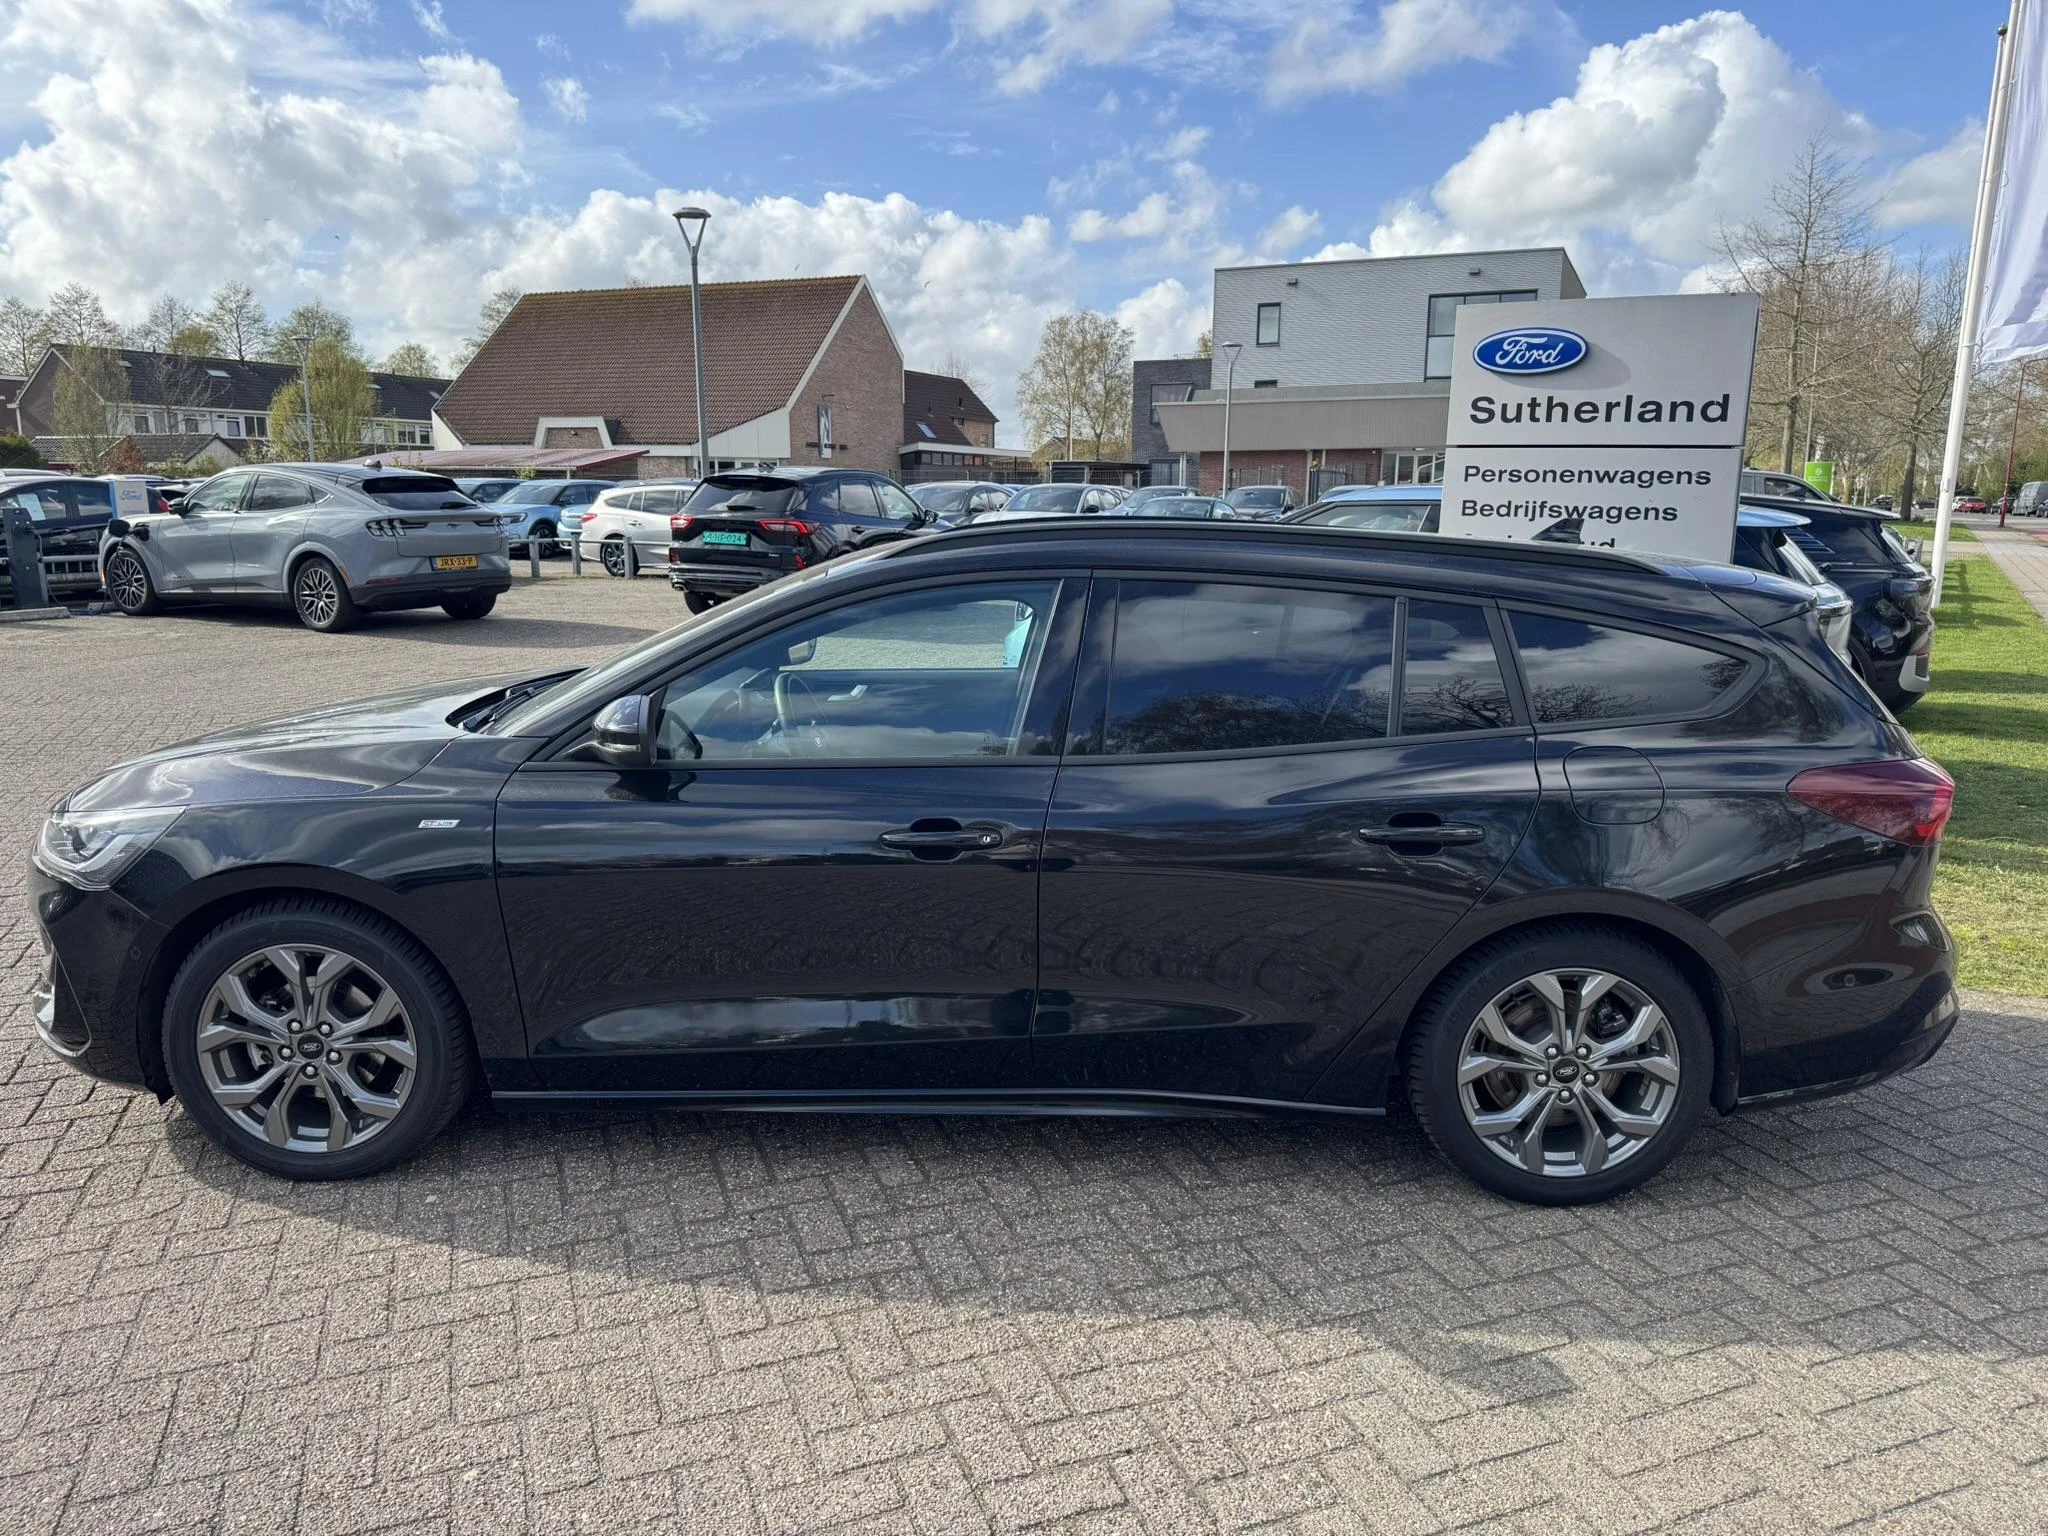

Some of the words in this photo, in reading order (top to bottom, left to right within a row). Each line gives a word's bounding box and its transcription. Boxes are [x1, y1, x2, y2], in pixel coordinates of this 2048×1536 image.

[1495, 336, 1564, 365] Ford
[1470, 394, 1731, 424] Sutherland
[1463, 465, 1713, 489] Personenwagens
[1461, 499, 1679, 525] Bedrijfswagens
